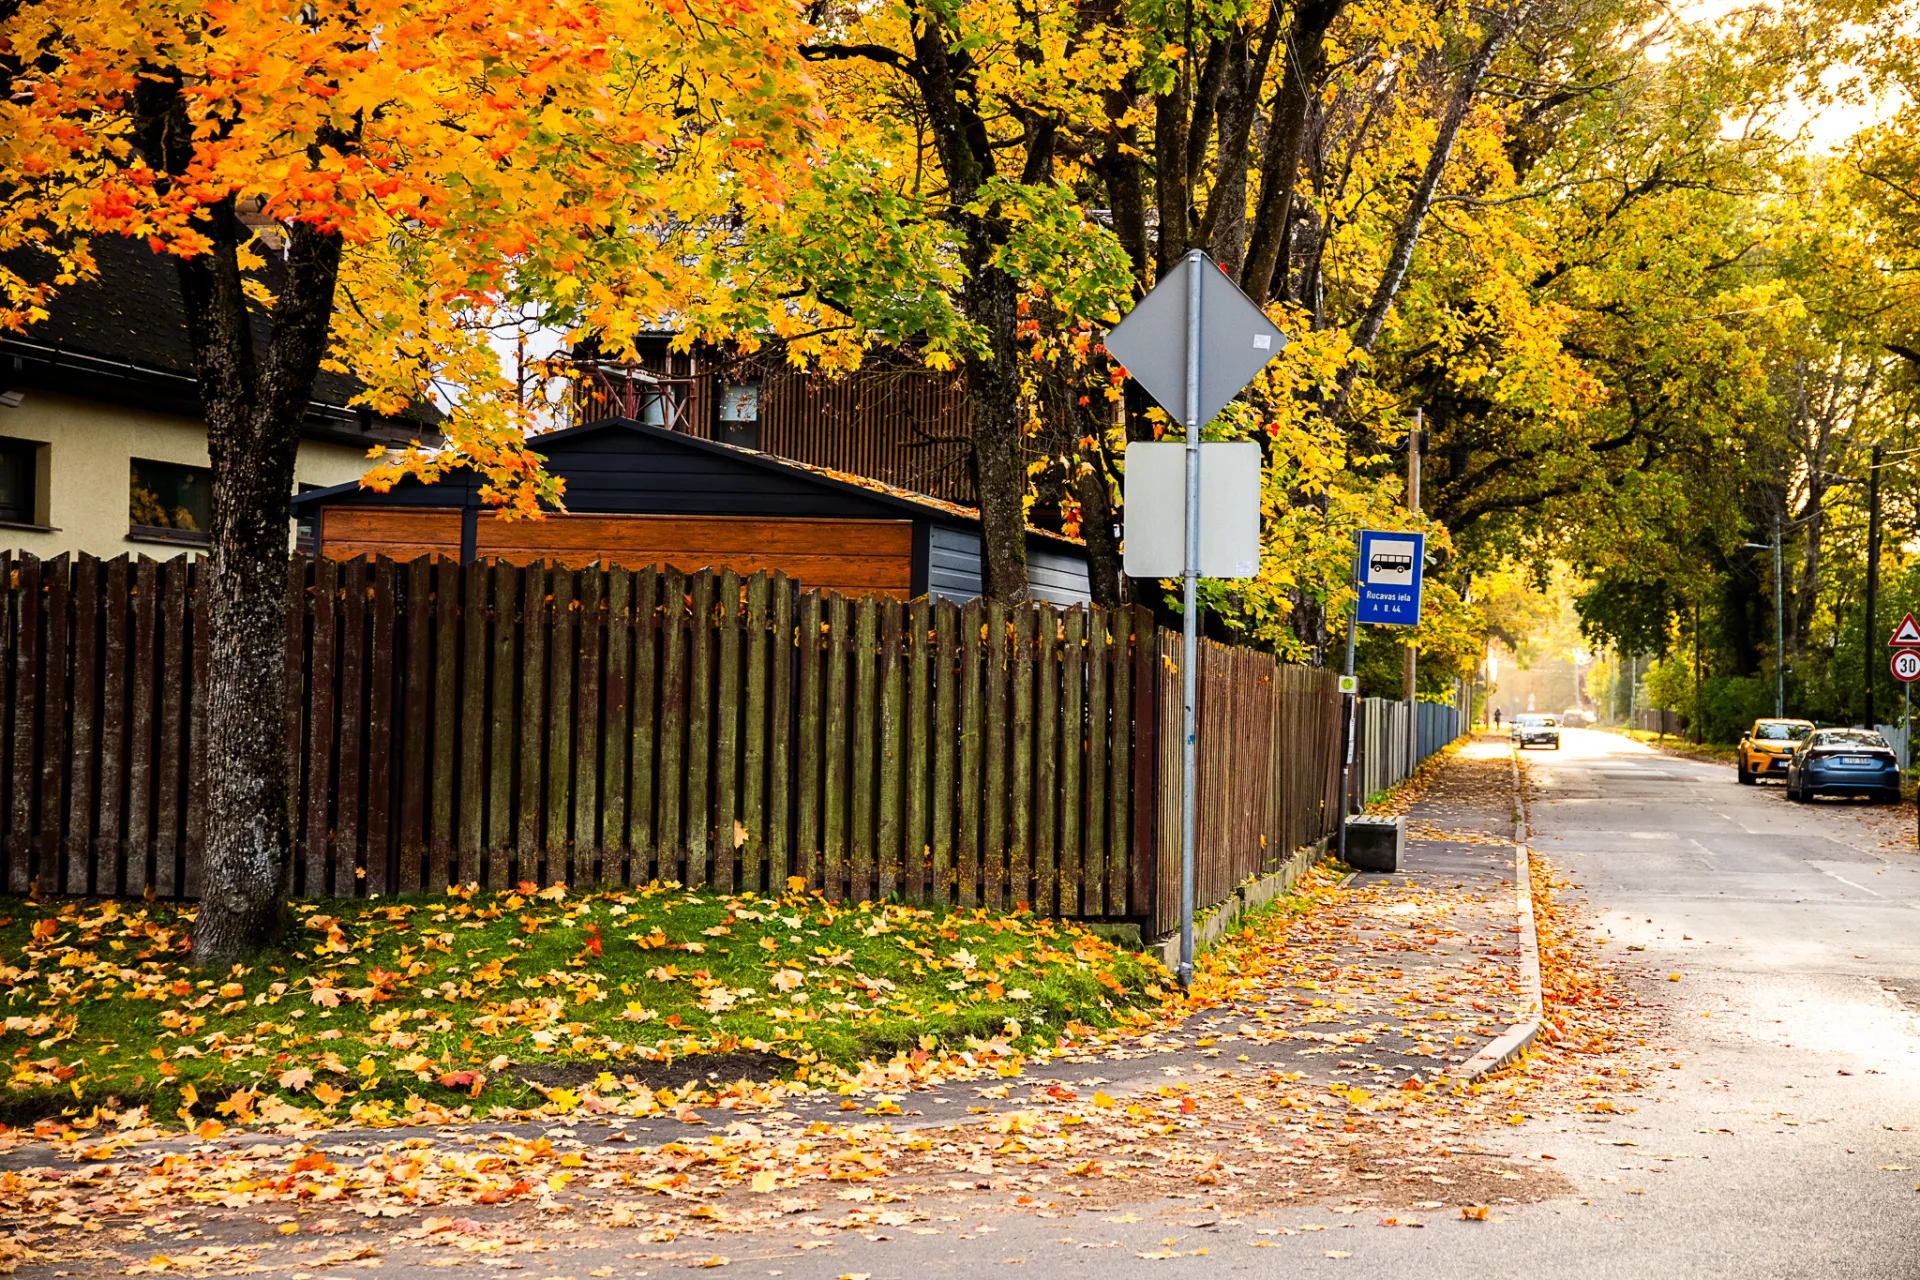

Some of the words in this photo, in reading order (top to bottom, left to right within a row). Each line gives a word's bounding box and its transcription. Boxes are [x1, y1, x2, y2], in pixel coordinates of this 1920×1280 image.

[1366, 590, 1396, 600] Rucavas
[1398, 593, 1411, 602] iela
[1373, 603, 1378, 611] A
[1900, 658, 1916, 673] 30
